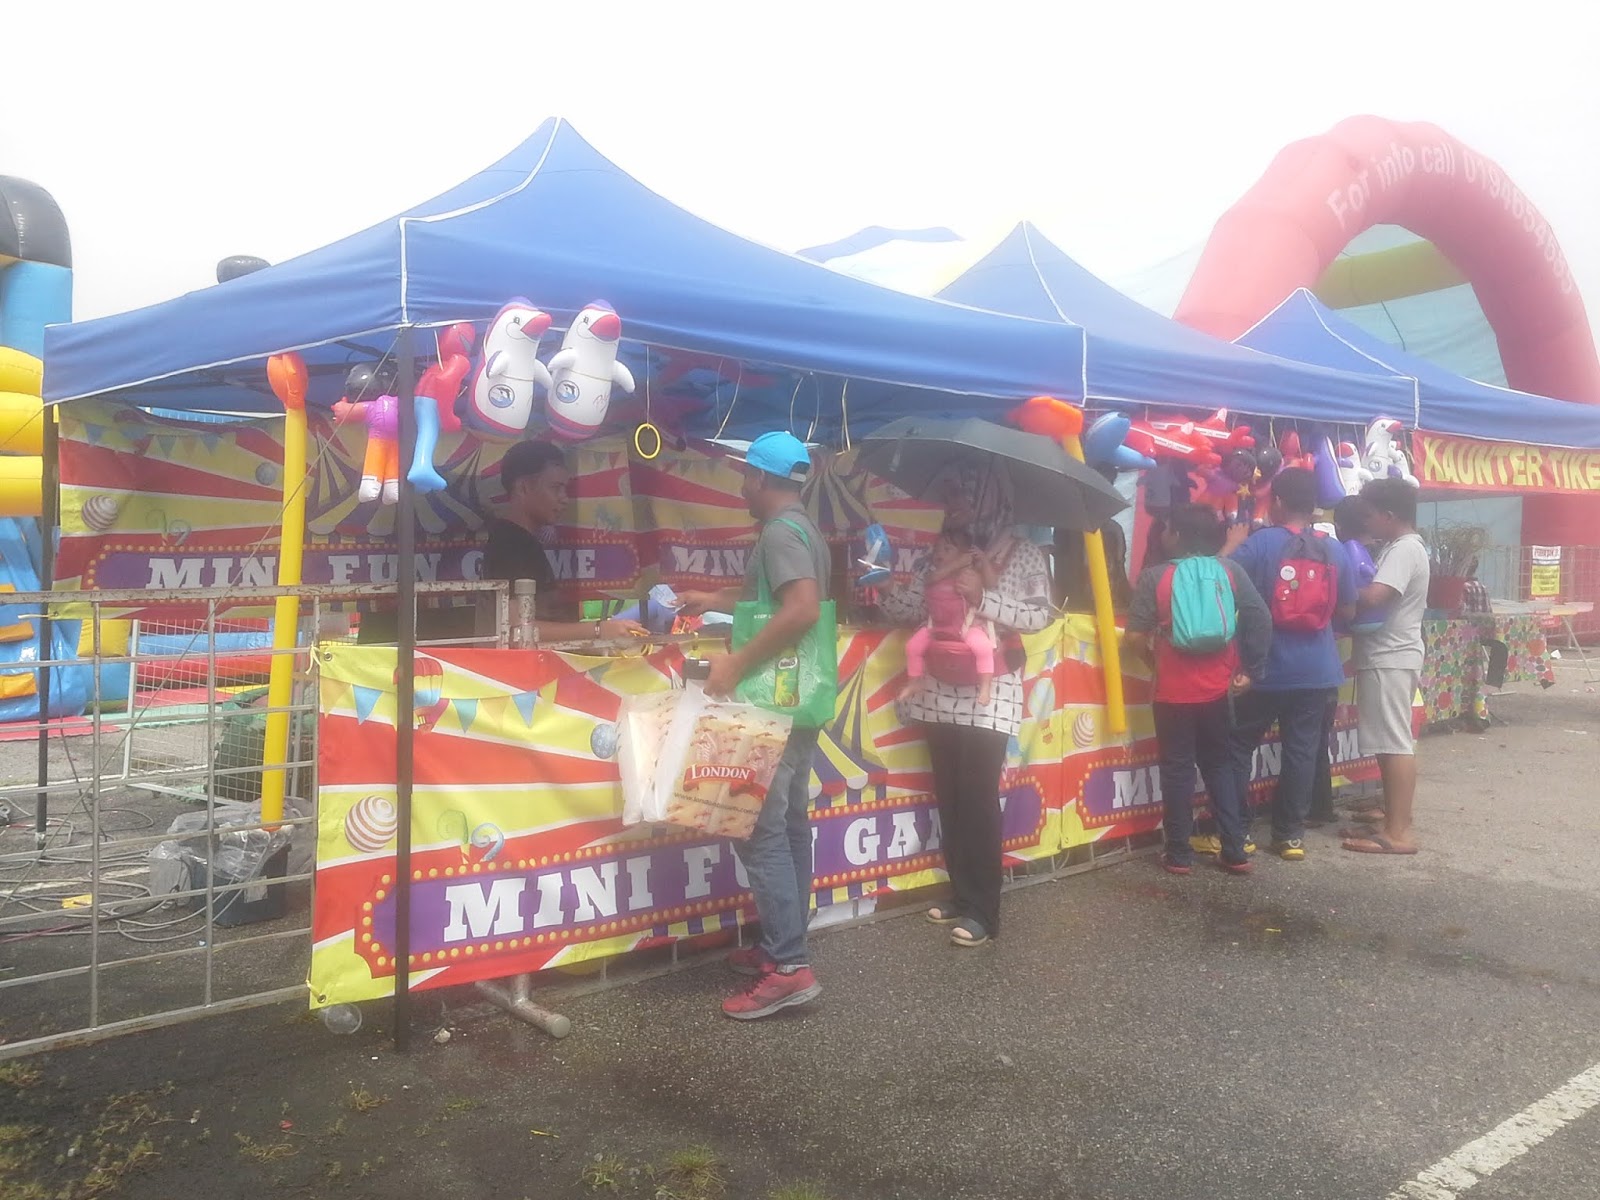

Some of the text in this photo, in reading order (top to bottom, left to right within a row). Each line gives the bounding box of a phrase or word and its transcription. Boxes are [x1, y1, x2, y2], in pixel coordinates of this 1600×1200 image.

[1327, 169, 1370, 231] For
[1370, 142, 1415, 192] info
[1422, 143, 1455, 176] call
[1424, 437, 1543, 487] KAUNTER
[146, 556, 301, 588] MIN
[461, 549, 596, 582] GME
[671, 546, 746, 576] MIN
[691, 763, 750, 780] LONDON
[444, 844, 653, 942] MINI
